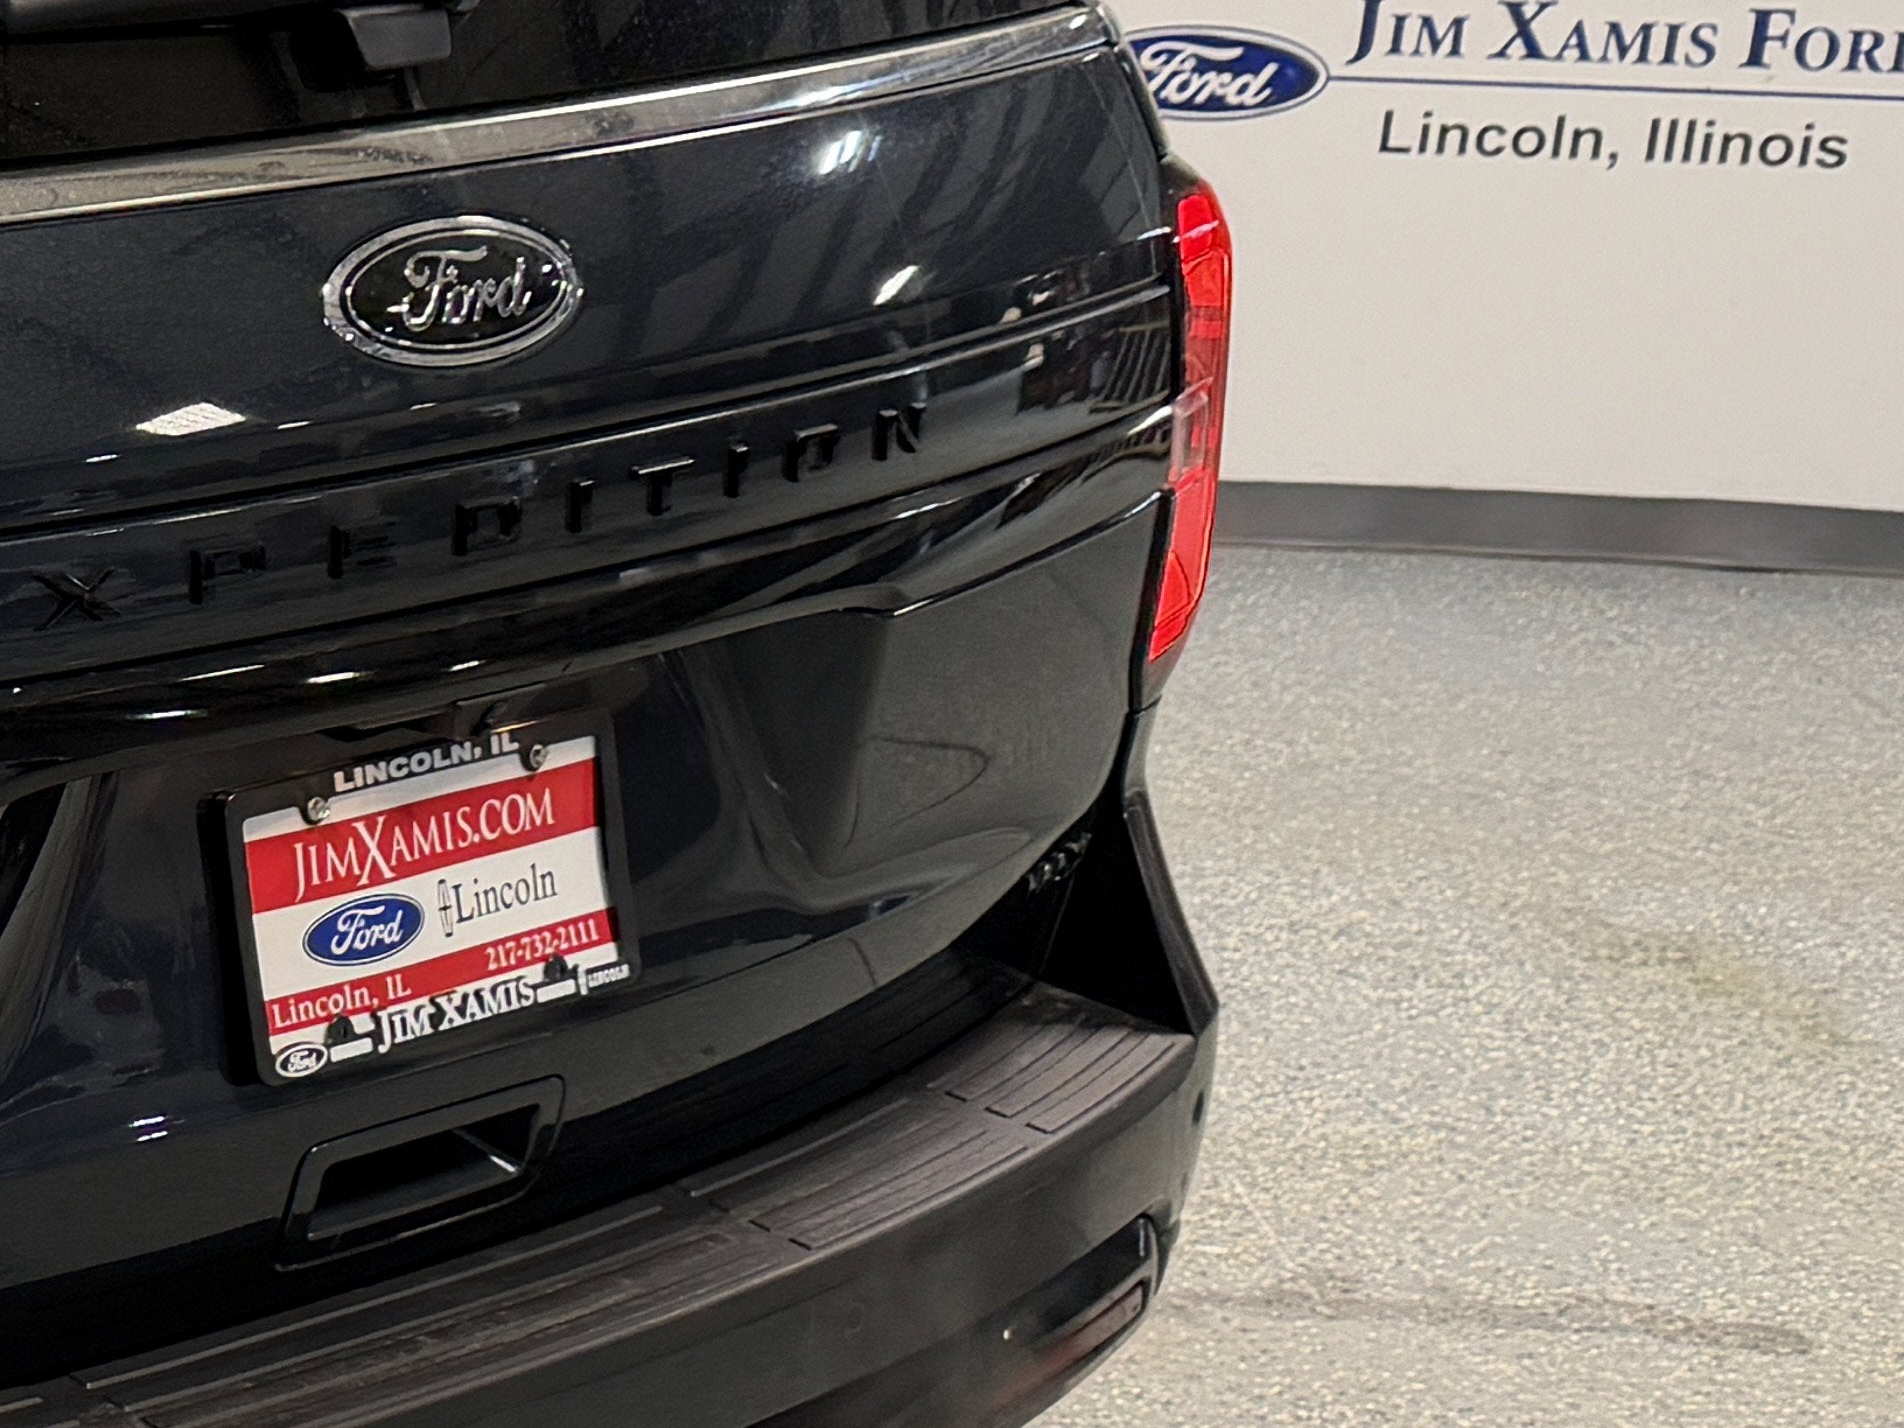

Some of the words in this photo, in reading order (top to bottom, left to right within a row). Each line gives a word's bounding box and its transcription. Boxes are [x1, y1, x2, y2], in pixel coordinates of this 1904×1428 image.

[1487, 0, 1718, 67] XAMIS
[1139, 40, 1280, 106] Ford
[1378, 110, 1619, 171] Lincoln,
[1644, 117, 1849, 170] Illinois
[403, 244, 533, 333] Ford
[333, 740, 483, 793] LINCOLN,
[489, 732, 520, 756] IL
[293, 787, 556, 902] JIMXAMIS.COM
[453, 862, 559, 925] Lincoln
[329, 905, 405, 955] Ford
[484, 917, 600, 972] 217-732-2111
[271, 983, 379, 1029] Lincoln,
[385, 973, 412, 1001] IL
[377, 1004, 437, 1054] JIM
[435, 975, 535, 1031] XAMIS
